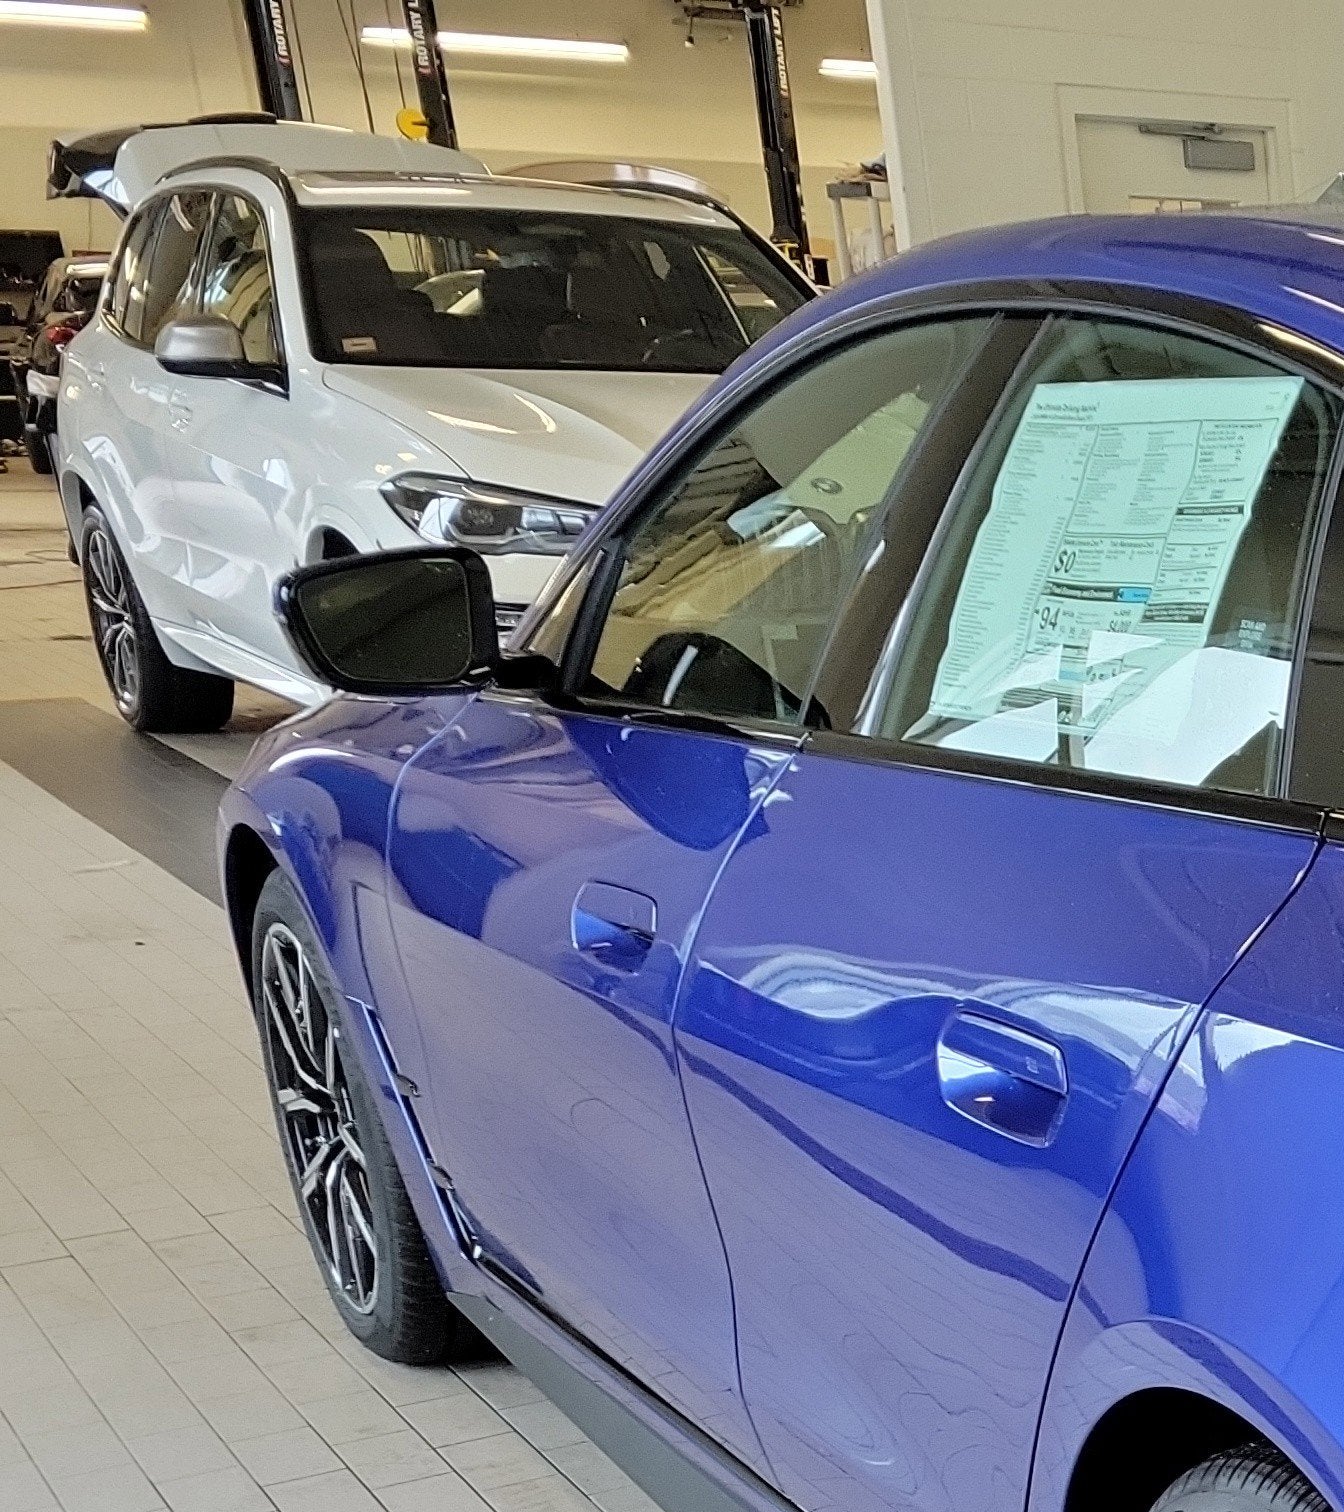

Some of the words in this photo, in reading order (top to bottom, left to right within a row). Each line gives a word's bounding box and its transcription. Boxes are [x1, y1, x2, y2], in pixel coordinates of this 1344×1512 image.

[409, 7, 429, 66] ROTARY
[770, 6, 782, 36] LIFT
[774, 37, 788, 90] ROTARY
